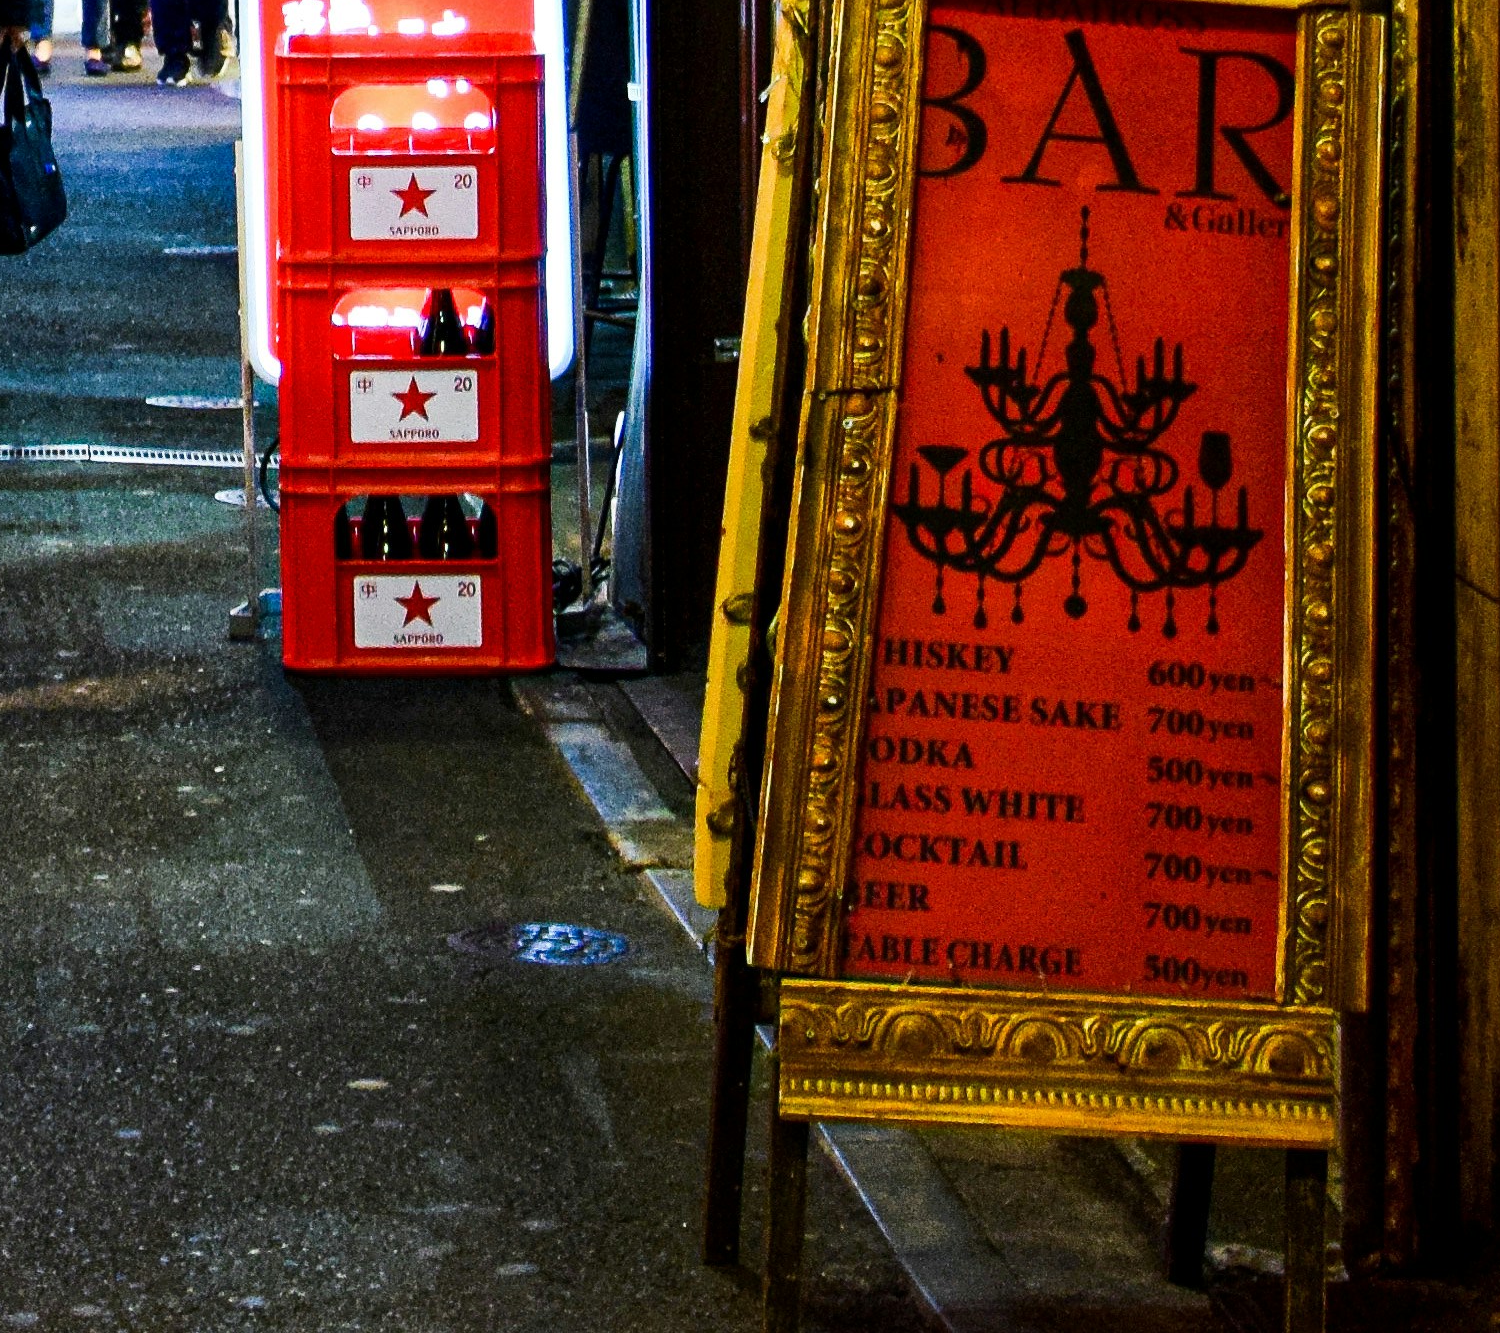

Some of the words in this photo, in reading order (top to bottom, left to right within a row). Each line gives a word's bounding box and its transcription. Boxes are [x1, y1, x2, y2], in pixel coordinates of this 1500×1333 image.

[917, 24, 1296, 208] BAR
[453, 173, 473, 190] 20
[389, 226, 440, 237] SAPPORO
[453, 375, 473, 393] 20
[389, 429, 441, 440] SAPPORO
[457, 580, 477, 598] 20
[392, 633, 444, 645] SAPPORO
[1029, 697, 1123, 732] SAKE
[1145, 707, 1255, 741] 700yen
[857, 780, 952, 815] LASS
[960, 786, 1086, 824] WHITE
[1145, 802, 1254, 836] 700yen
[858, 831, 1029, 870] OCKTAIL
[1143, 901, 1253, 936] 700yen
[946, 938, 1084, 978] CHARGE
[1143, 953, 1249, 992] 500yen
